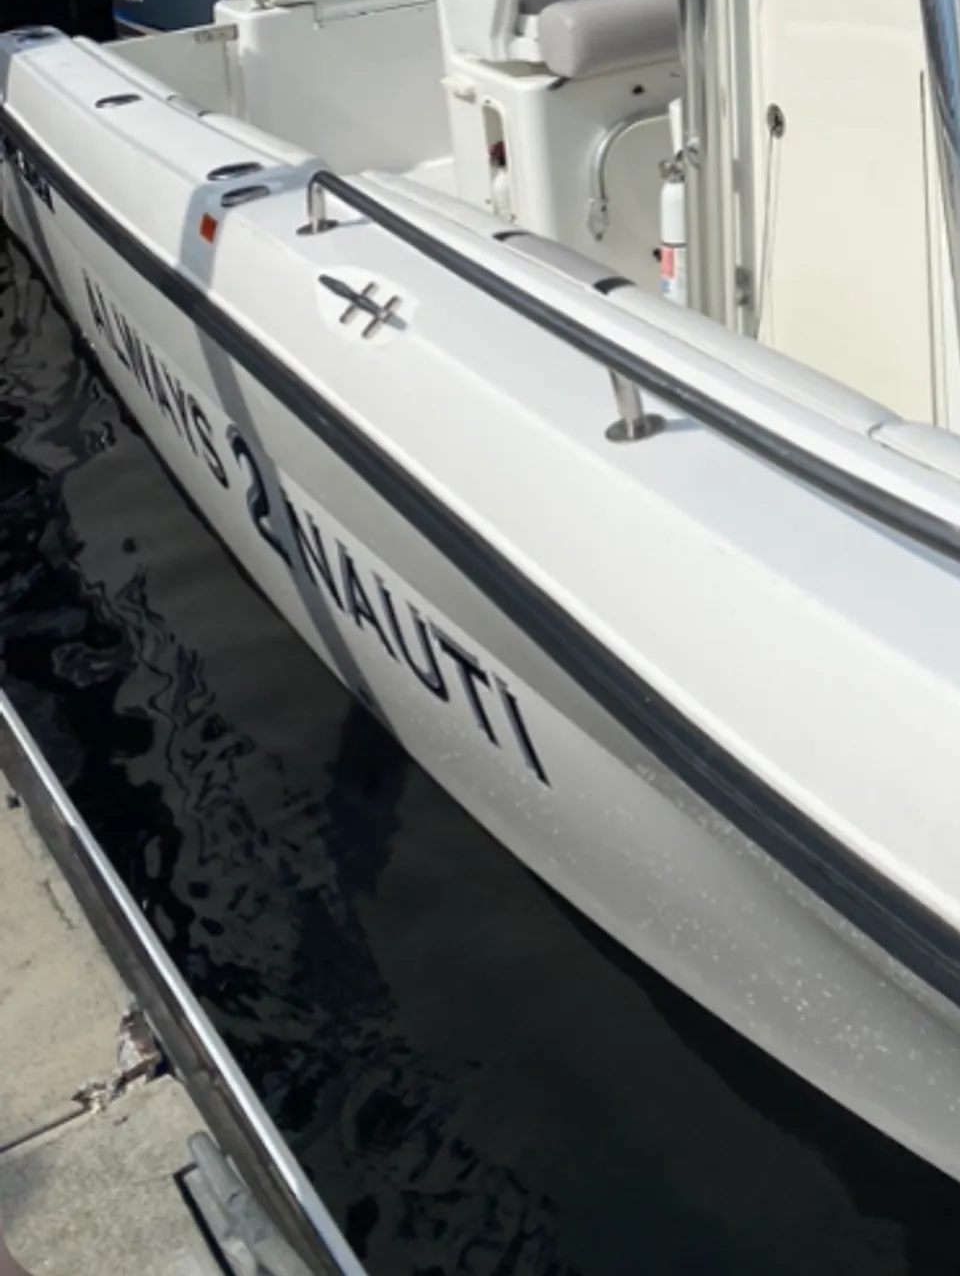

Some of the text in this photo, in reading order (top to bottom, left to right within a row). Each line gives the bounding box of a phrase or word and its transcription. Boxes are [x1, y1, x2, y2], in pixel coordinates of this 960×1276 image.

[83, 268, 552, 789] ALWAYS 2 NAUTI
